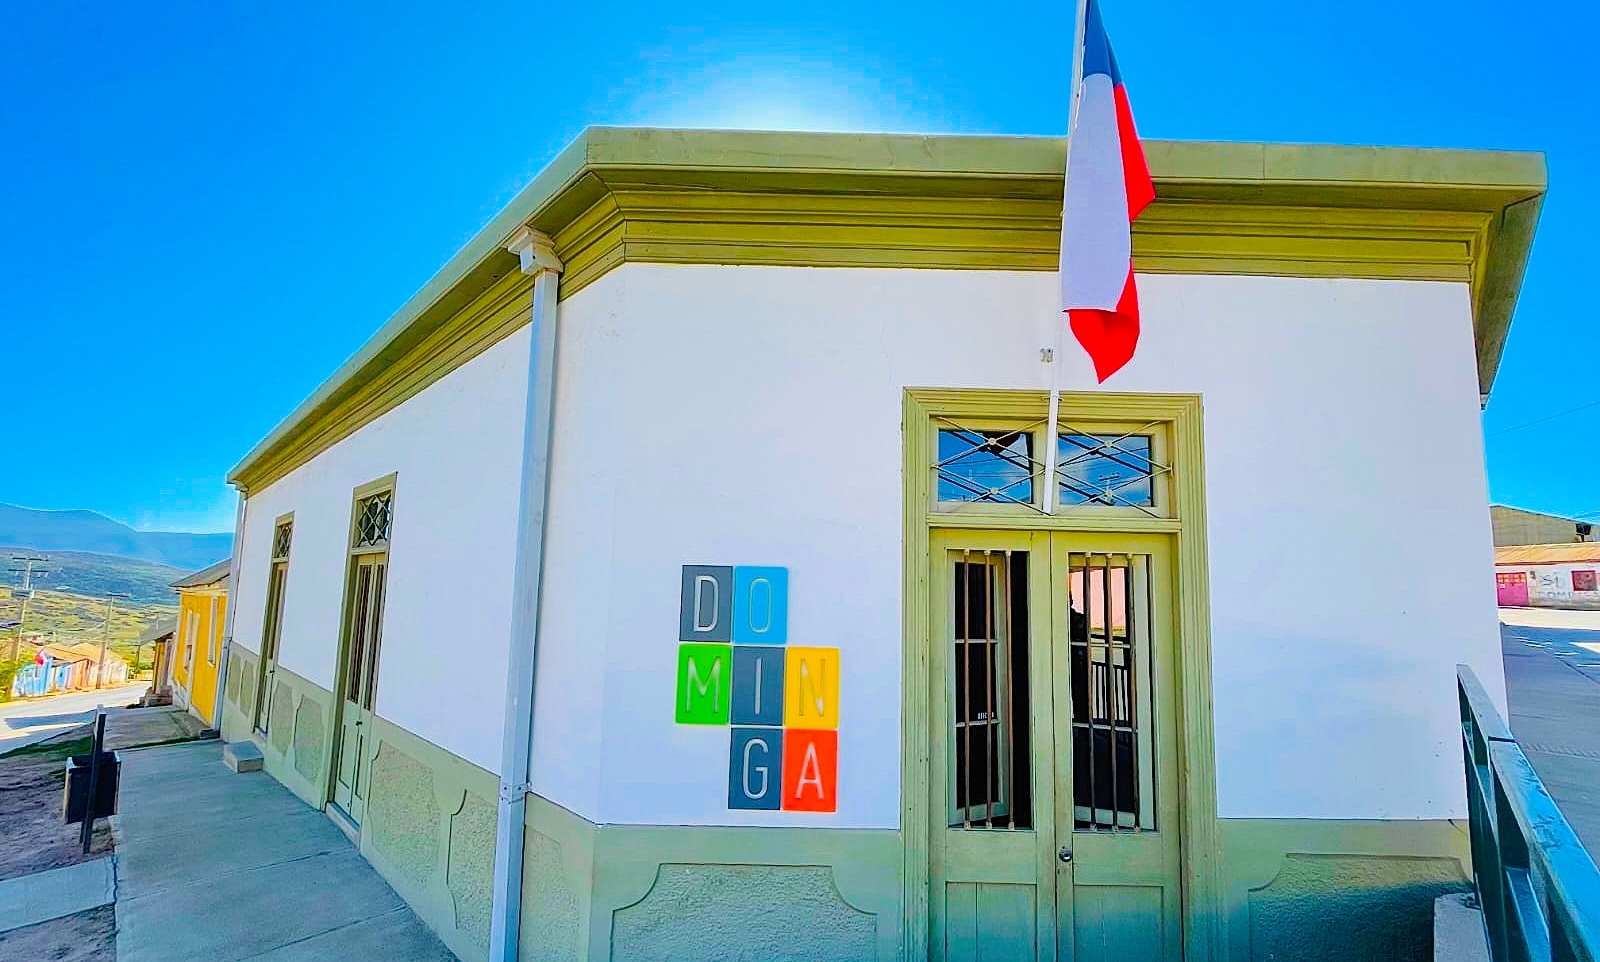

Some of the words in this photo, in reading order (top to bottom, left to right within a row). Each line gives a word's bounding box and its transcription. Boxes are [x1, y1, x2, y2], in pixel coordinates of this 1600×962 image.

[693, 575, 771, 633] DO
[685, 656, 825, 717] MIN
[742, 738, 824, 800] GA
